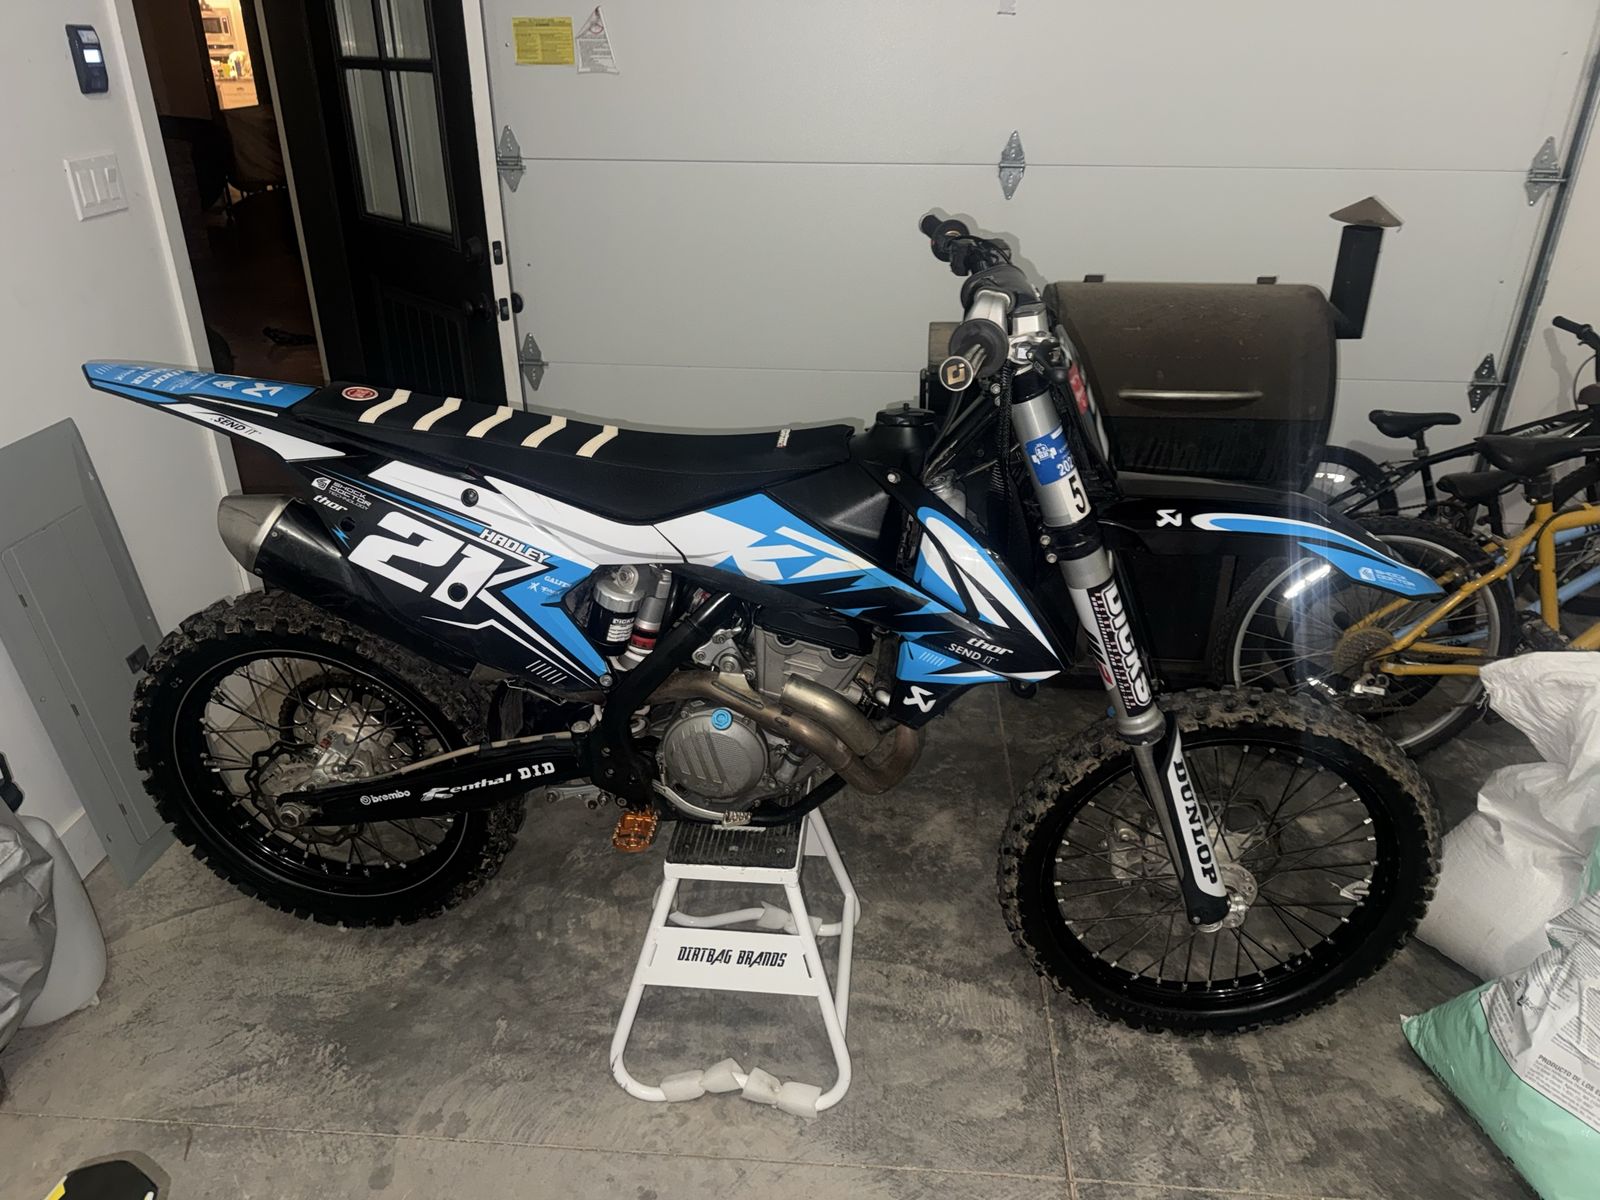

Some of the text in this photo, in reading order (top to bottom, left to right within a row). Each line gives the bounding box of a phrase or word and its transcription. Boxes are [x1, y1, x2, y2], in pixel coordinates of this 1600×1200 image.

[213, 416, 258, 436] SEND IT
[330, 485, 372, 507] DOCTOR
[333, 481, 367, 499] SHOCK
[1068, 474, 1086, 514] 5
[313, 494, 349, 511] thor
[479, 528, 551, 563] HADLEY
[347, 511, 504, 610] 21
[948, 643, 982, 660] SEND
[966, 637, 1014, 655] thor
[370, 790, 411, 803] brembo
[1173, 760, 1218, 885] DUNLOP
[677, 946, 788, 968] DIRTBAG BRANDS
[1538, 1054, 1572, 1077] PRODUCTO
